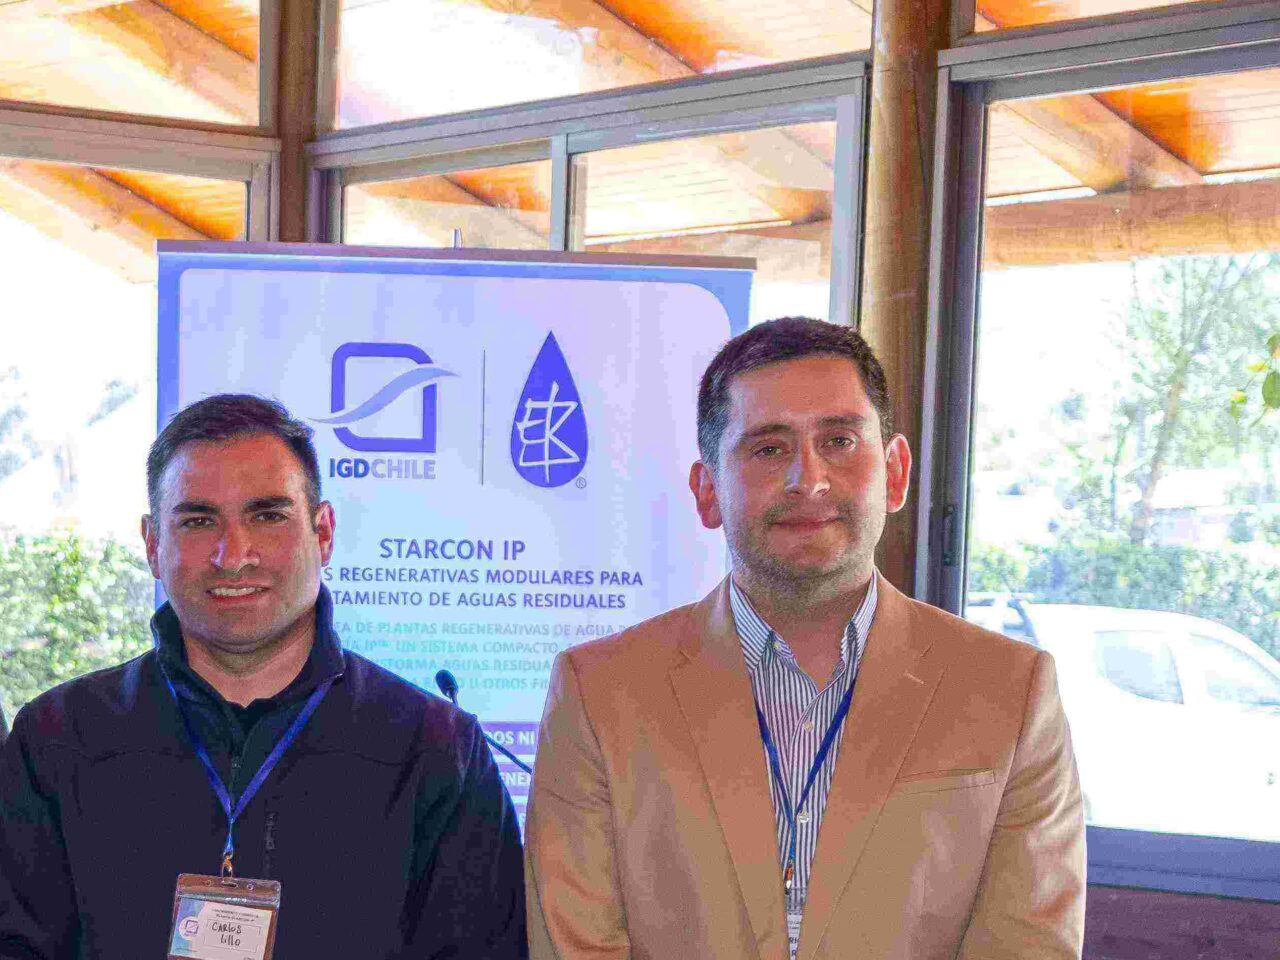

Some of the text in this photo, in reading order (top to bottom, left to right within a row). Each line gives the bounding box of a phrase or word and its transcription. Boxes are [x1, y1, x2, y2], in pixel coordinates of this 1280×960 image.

[329, 457, 437, 480] IGDCHILE
[380, 538, 526, 561] STARCON IP
[340, 567, 479, 583] REGENERATIVAS
[486, 569, 594, 585] MODULARES
[600, 571, 643, 586] PARA
[333, 590, 626, 609] TAMIENTO DE AGUAS RESIDUALES
[442, 623, 550, 636] REGENERATIVAS
[553, 624, 571, 636] DE
[494, 659, 550, 671] RESIDUA
